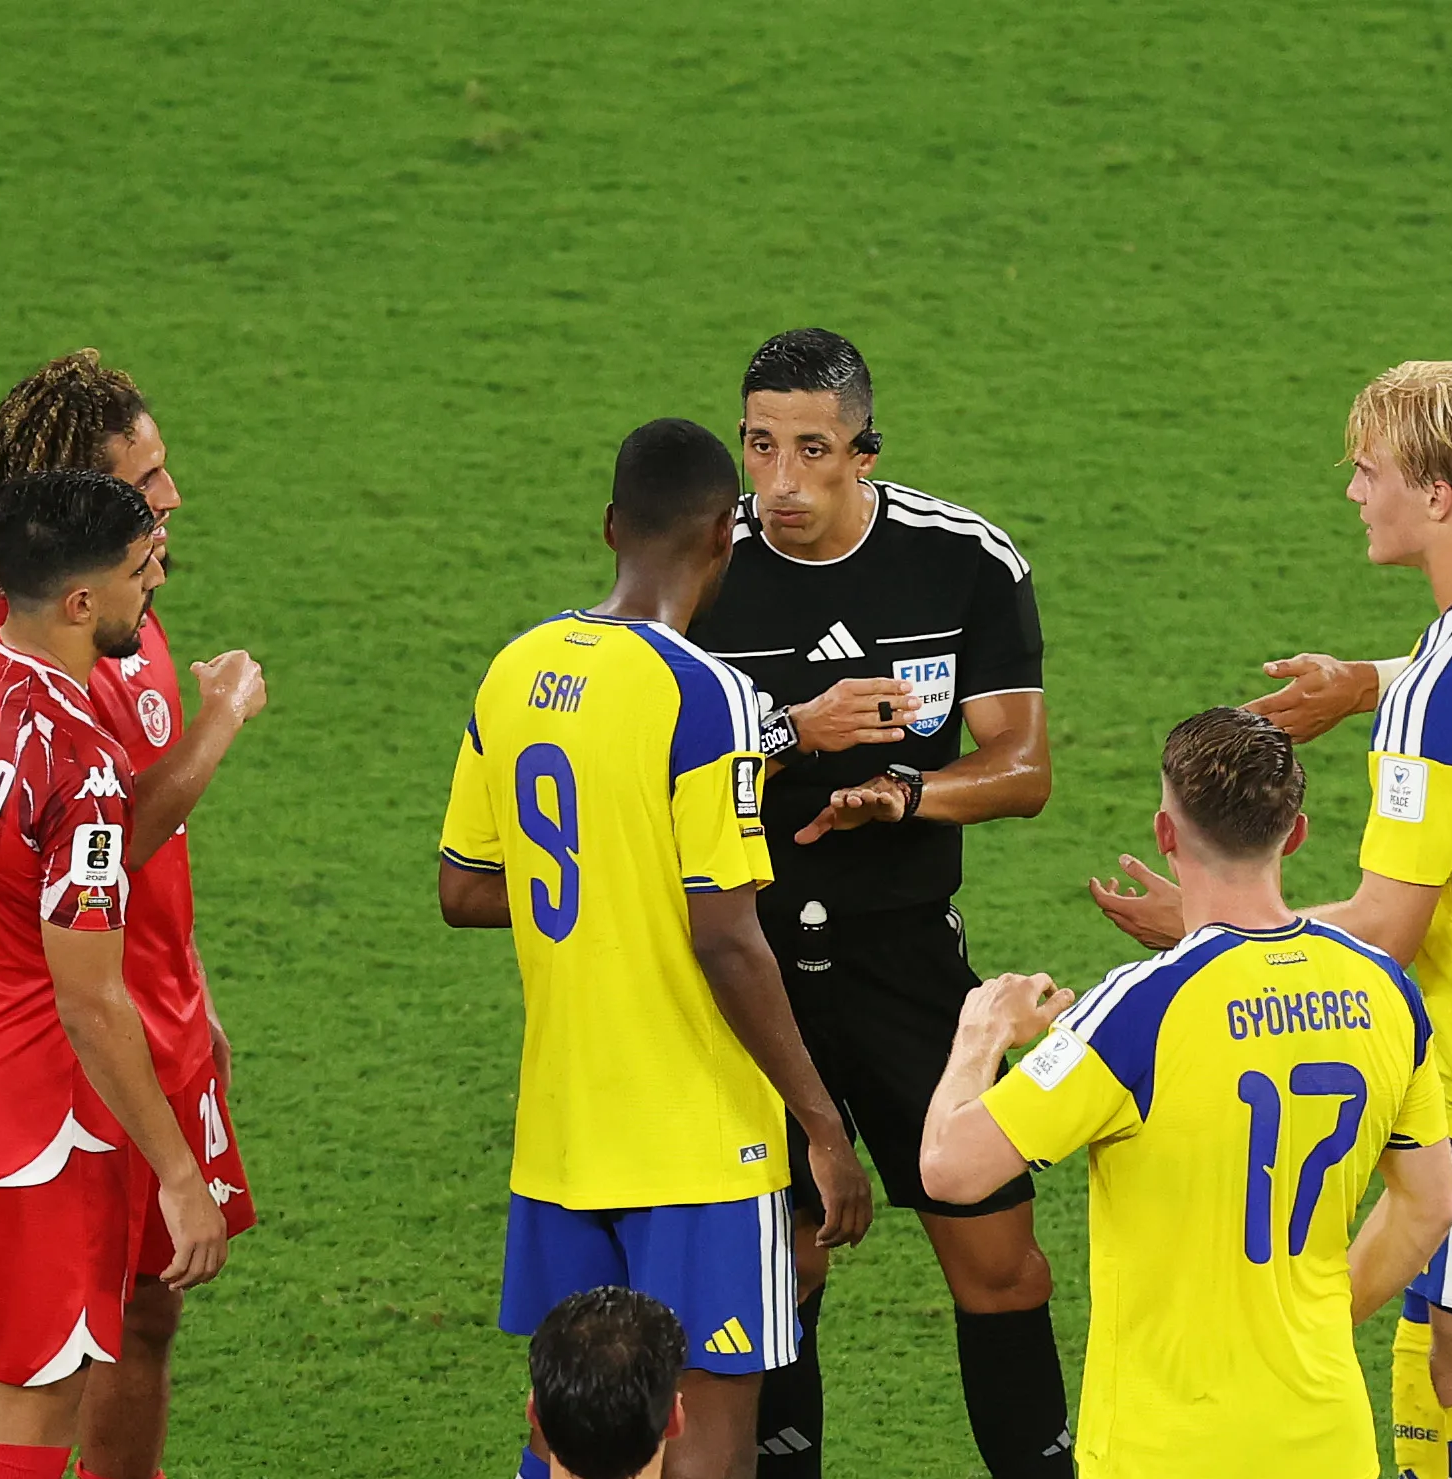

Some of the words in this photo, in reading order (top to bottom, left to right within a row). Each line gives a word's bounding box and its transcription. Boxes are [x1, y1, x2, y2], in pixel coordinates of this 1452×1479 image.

[900, 661, 951, 682] FIFA
[528, 669, 588, 713] ISAK
[918, 690, 950, 704] EREE
[916, 718, 939, 730] 2026
[1390, 794, 1410, 807] PEACE
[515, 742, 580, 944] 9
[1227, 986, 1371, 1040] GYÖKERES
[1237, 1061, 1368, 1265] 17
